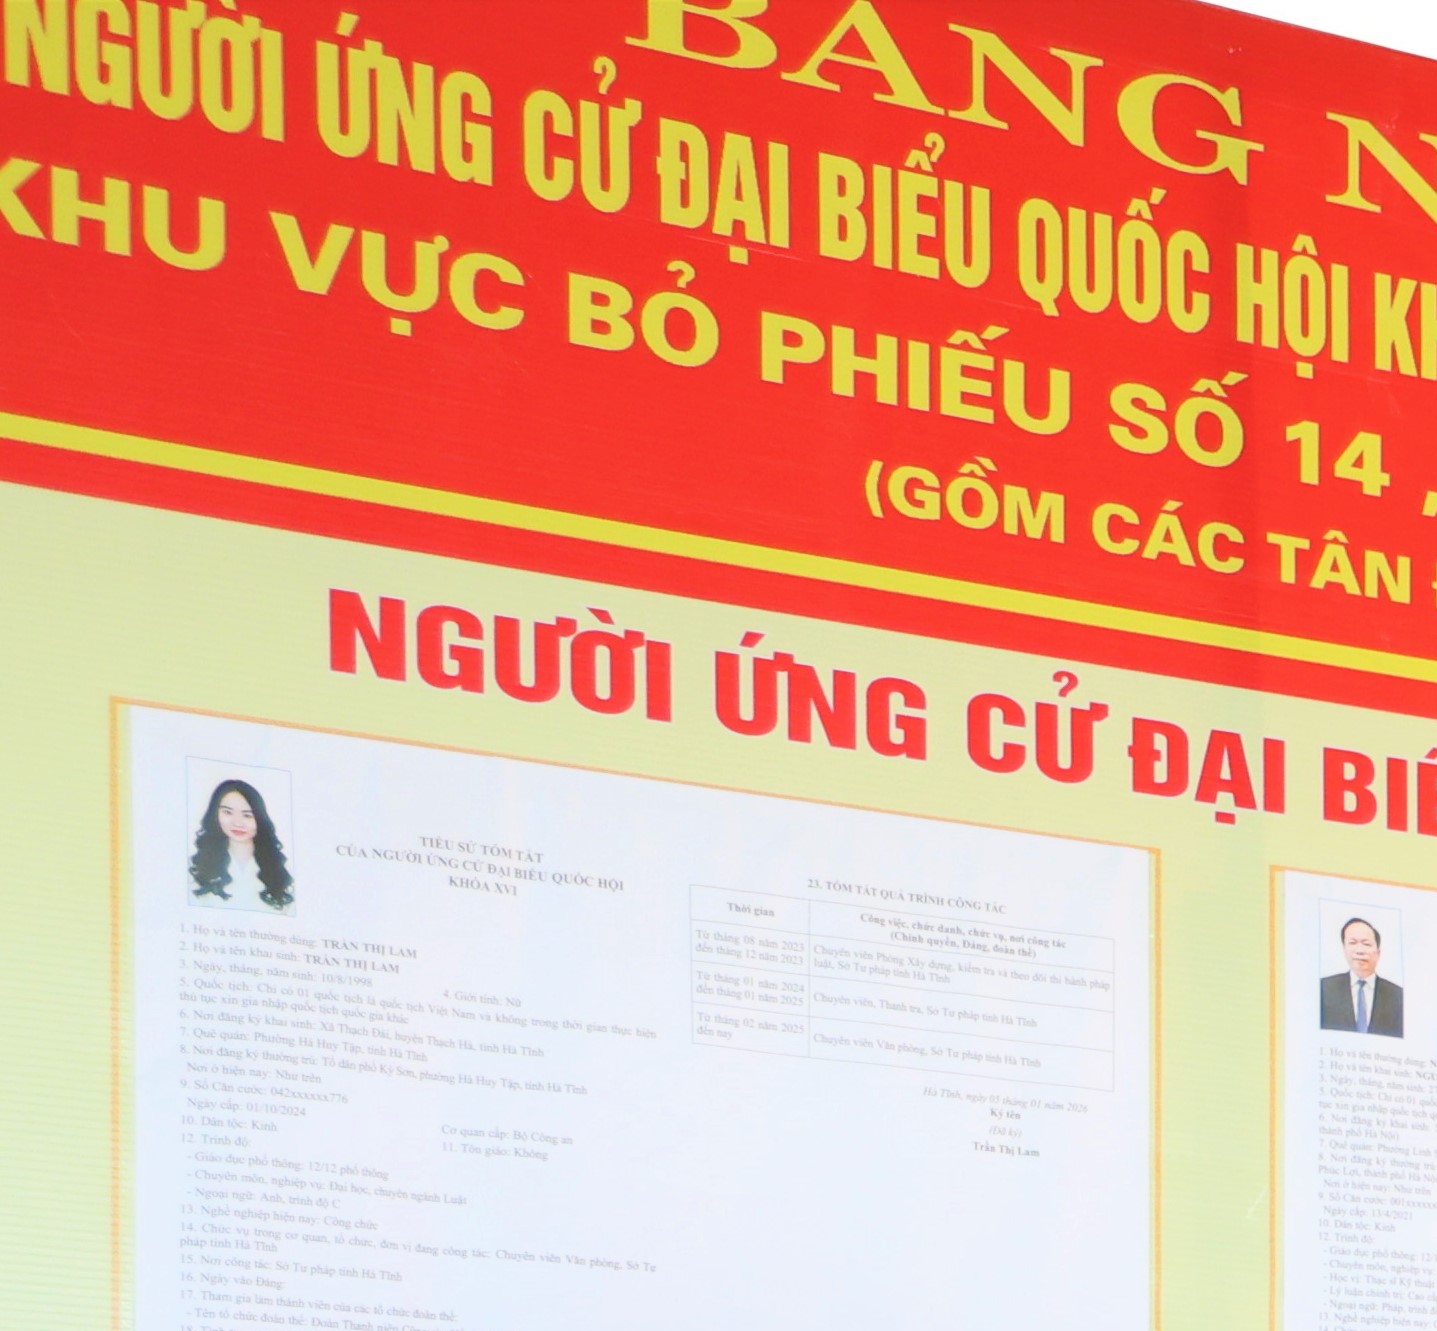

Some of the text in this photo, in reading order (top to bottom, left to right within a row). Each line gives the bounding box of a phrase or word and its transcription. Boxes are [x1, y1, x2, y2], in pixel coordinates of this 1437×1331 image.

[4, 0, 284, 141] NGƯỜI
[316, 12, 492, 186] ỨNG
[523, 57, 641, 212] CỬ
[656, 118, 789, 264] ĐẠI
[819, 132, 990, 287] BIỂU
[1018, 188, 1209, 333] QUỐC
[1237, 234, 1349, 379] HỘI
[0, 158, 225, 270] KHU
[270, 212, 524, 336] VỰC
[569, 260, 719, 366] BỎ
[761, 311, 1070, 434] PHIẾU
[1109, 372, 1248, 467] SỐ
[1286, 421, 1390, 496] 14
[865, 457, 1064, 543] (GỒM
[1092, 500, 1244, 573] CÁC
[1267, 530, 1410, 604] TÂN
[330, 589, 671, 721] NGƯỜI
[715, 632, 926, 760] ỨNG
[967, 671, 1108, 783] CỬ
[1128, 718, 1284, 824] ĐẠI
[449, 876, 518, 896] KHÓA XVI
